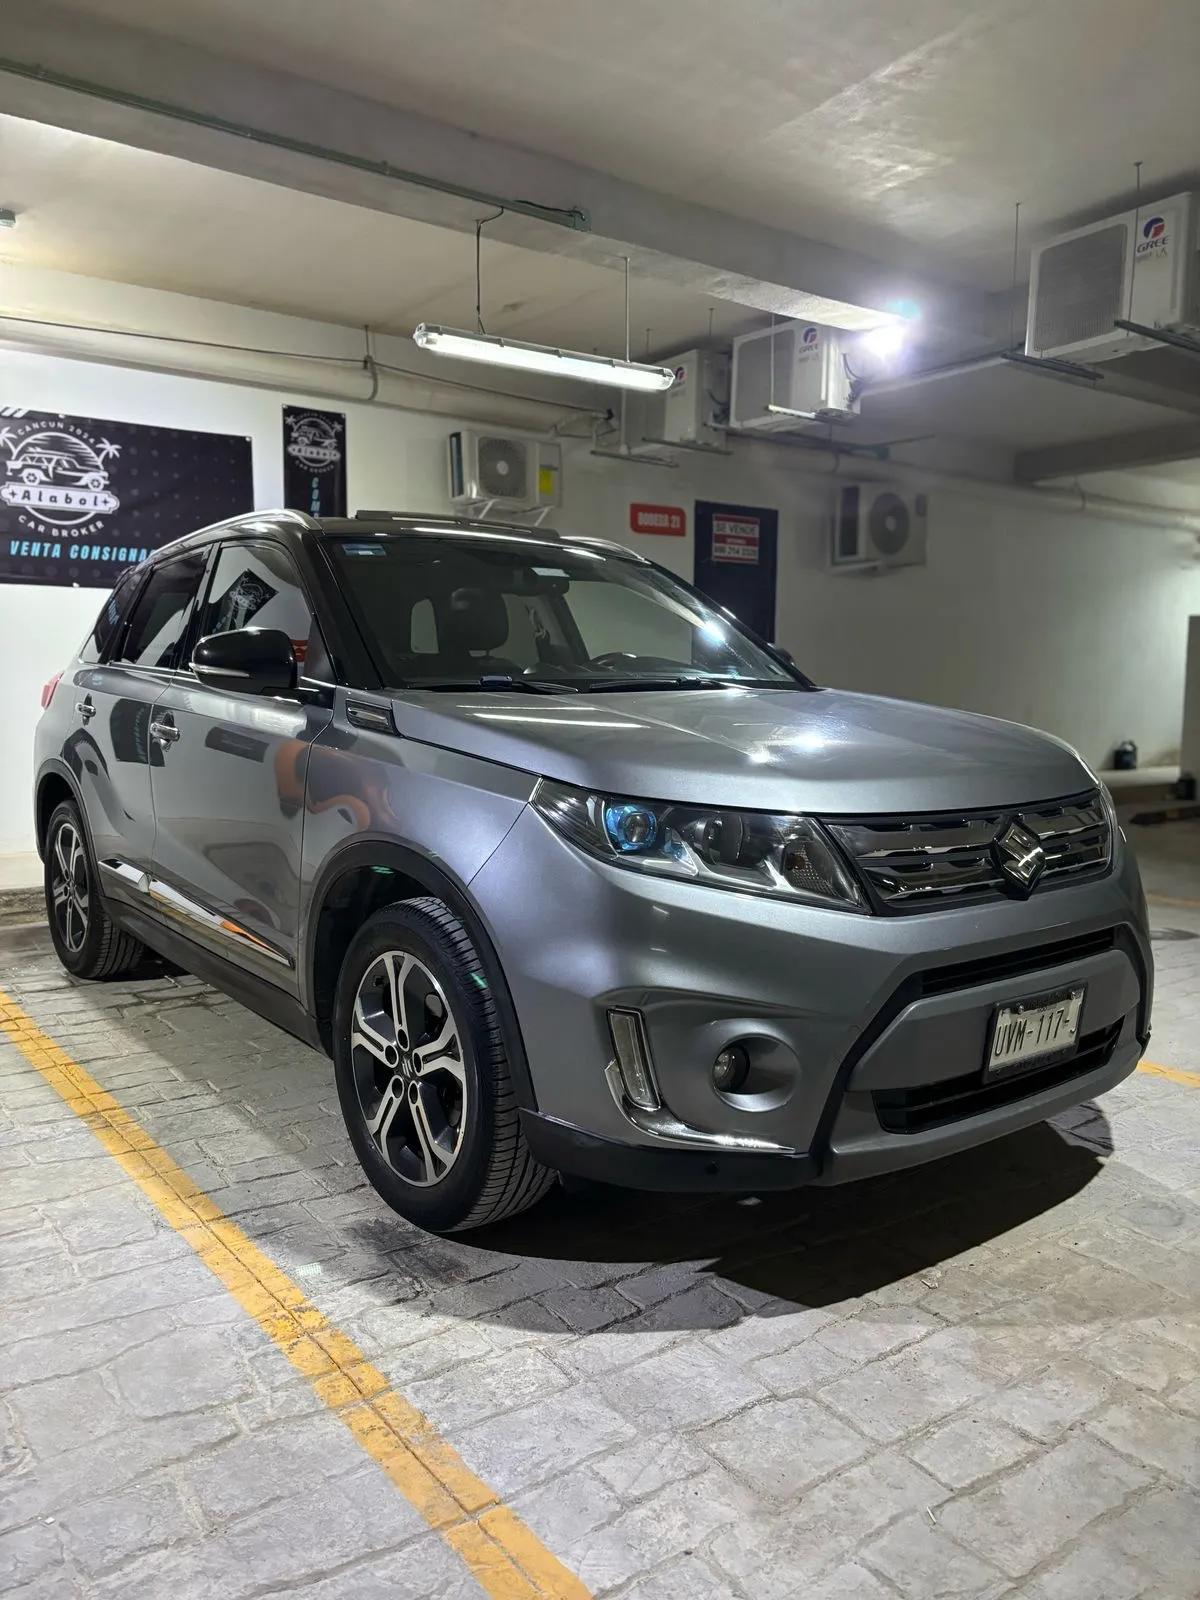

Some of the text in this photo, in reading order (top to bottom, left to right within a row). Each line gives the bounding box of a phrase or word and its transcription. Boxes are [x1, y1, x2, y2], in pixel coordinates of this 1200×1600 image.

[1137, 236, 1168, 253] GREE
[17, 421, 96, 444] CANCUN 2024
[21, 490, 98, 507] Alabol
[18, 514, 105, 538] CAR BROKER
[10, 540, 156, 562] VENTA CONSIGNA
